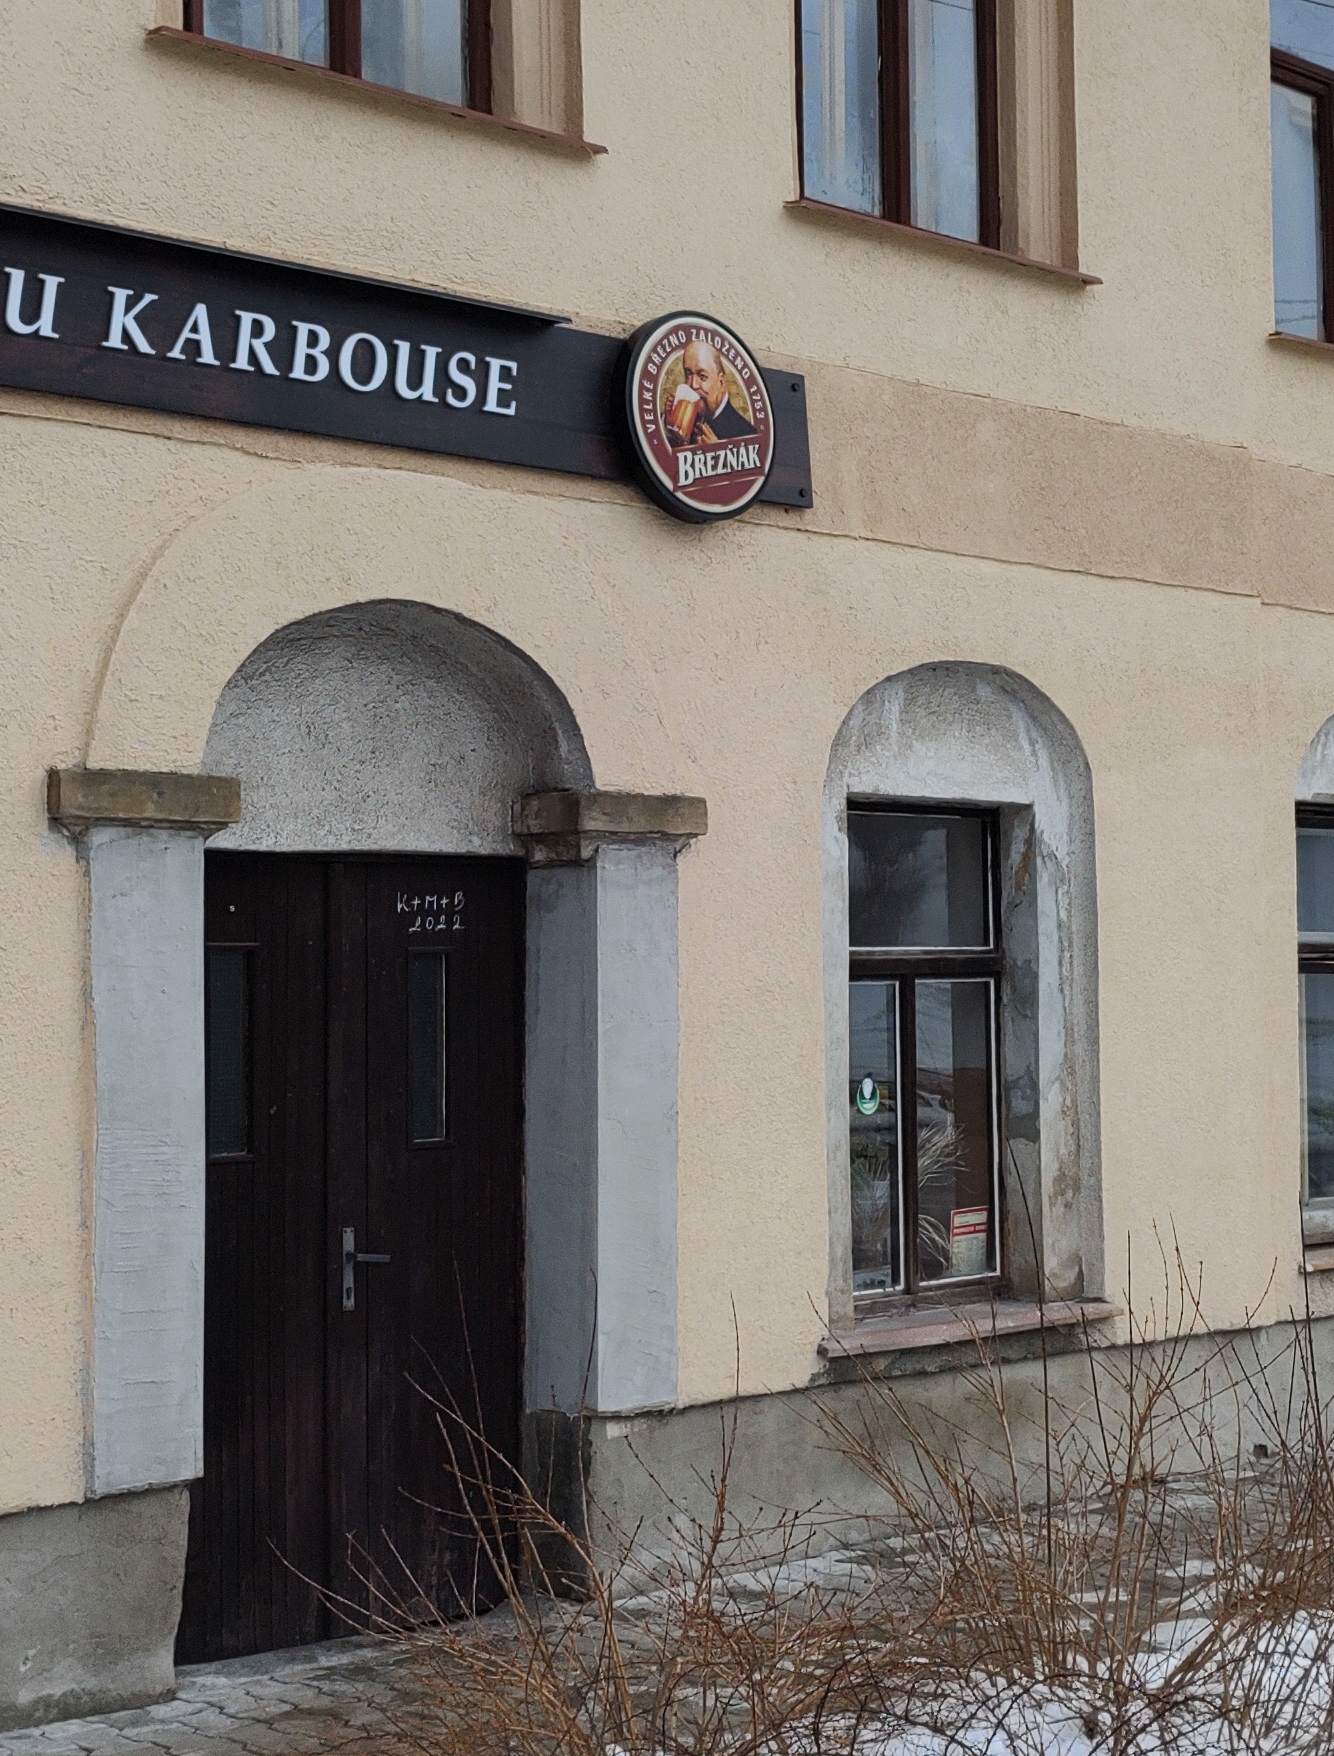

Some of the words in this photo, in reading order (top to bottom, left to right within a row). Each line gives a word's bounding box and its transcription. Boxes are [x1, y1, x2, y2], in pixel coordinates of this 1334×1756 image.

[3, 266, 66, 339] U
[99, 285, 518, 416] KARBOUSE
[647, 330, 687, 376] BŘEZNO
[690, 328, 751, 381] ZALOŽENO
[642, 379, 656, 434] VELKÉ
[749, 385, 766, 419] 1753
[676, 443, 762, 487] BŘEZŇÁK
[408, 914, 466, 934] 2022
